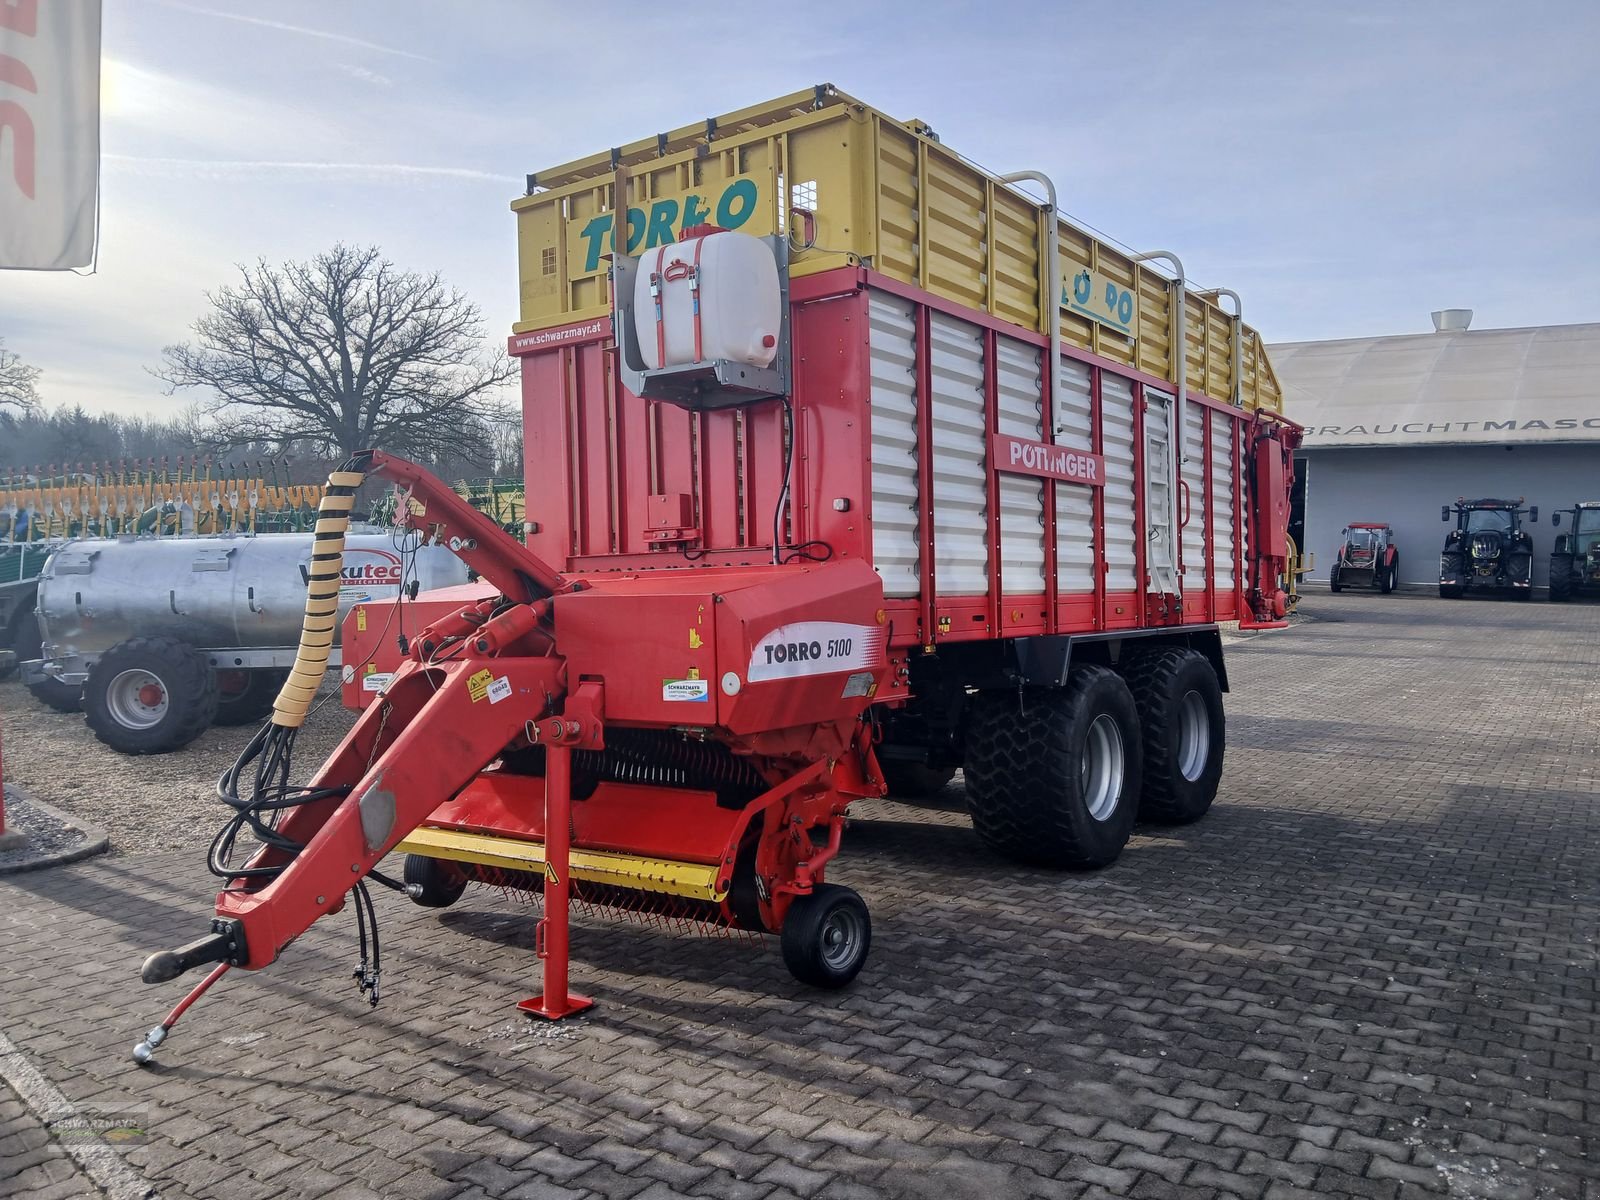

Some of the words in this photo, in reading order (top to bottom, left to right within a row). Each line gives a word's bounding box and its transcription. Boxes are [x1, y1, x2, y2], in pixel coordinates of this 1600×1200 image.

[515, 321, 601, 348] www.schwarzmayr.at
[298, 563, 401, 587] Vkutec
[764, 641, 821, 665] TORRO
[827, 638, 852, 659] 5100
